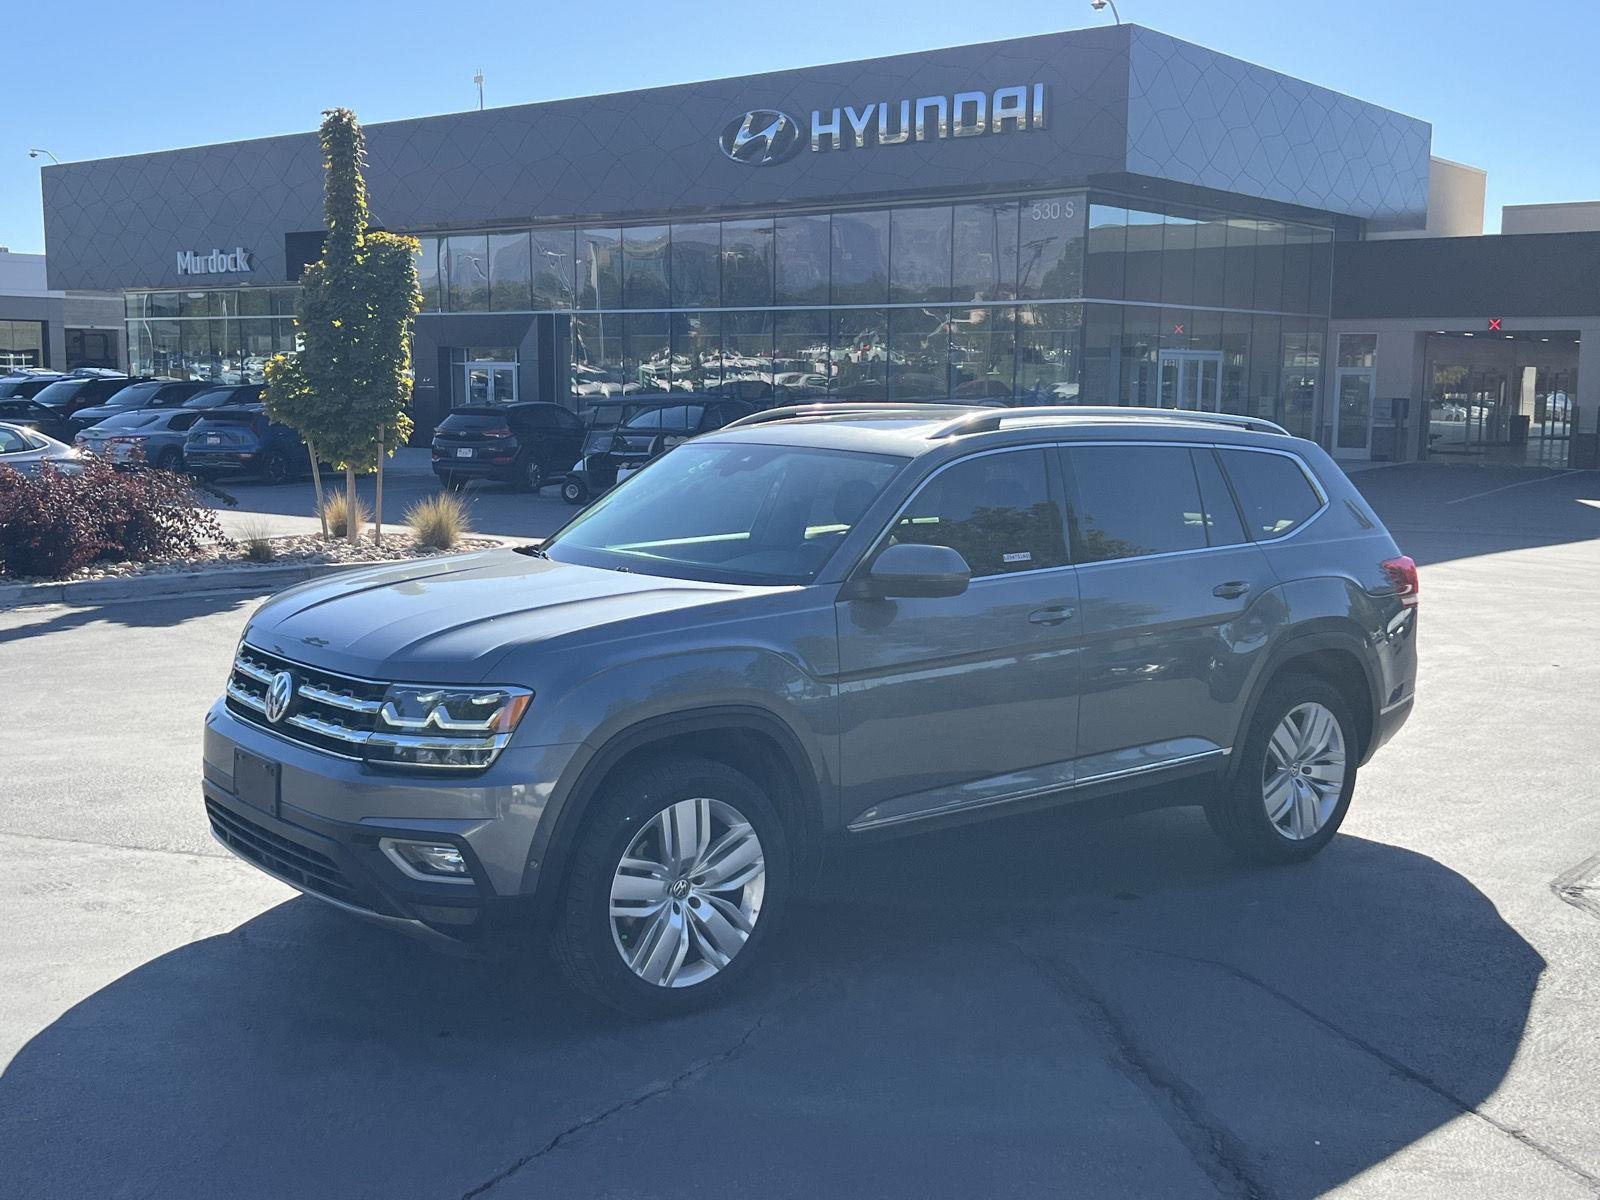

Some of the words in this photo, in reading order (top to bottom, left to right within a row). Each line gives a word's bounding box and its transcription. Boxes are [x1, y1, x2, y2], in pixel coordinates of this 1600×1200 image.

[810, 82, 1045, 153] HYUNDAI
[1032, 202, 1060, 220] 530
[1065, 201, 1074, 218] S
[176, 246, 251, 275] Murdock
